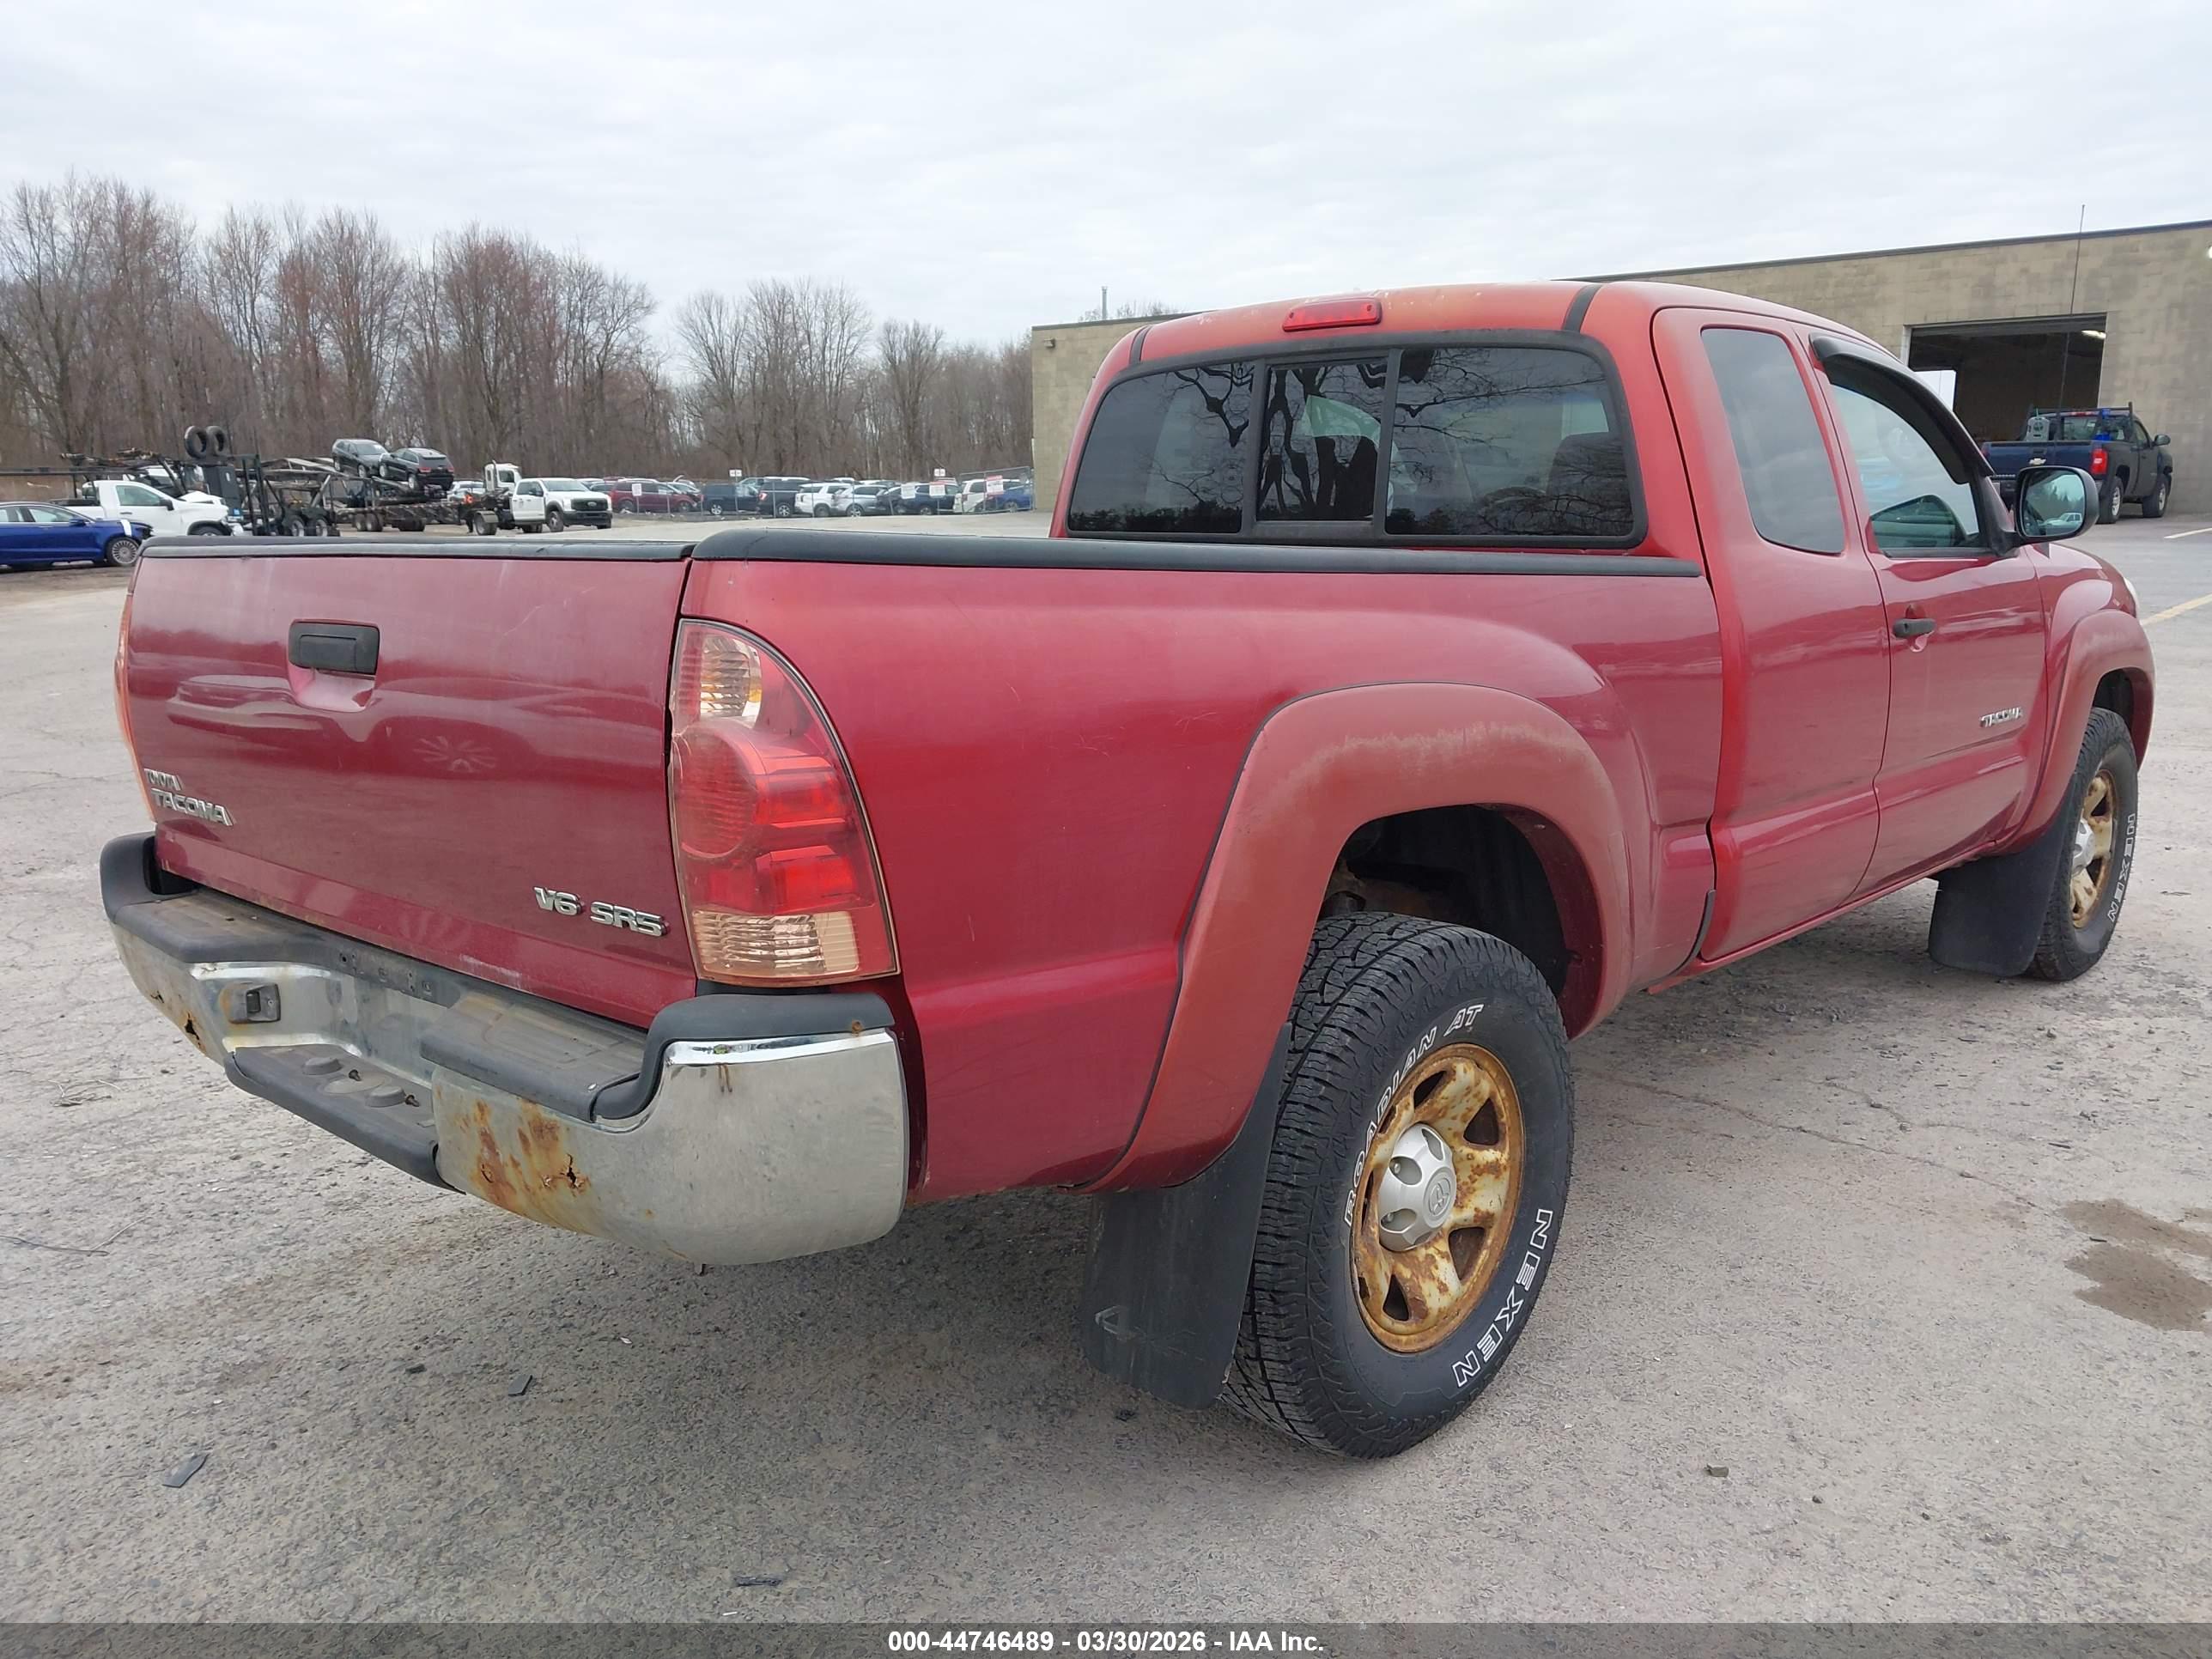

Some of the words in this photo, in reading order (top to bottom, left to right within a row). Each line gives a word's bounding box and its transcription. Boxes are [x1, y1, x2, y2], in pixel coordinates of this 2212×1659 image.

[151, 787, 234, 826] TACOMA
[533, 886, 580, 916] V6
[590, 901, 665, 938] SR5
[2107, 813, 2136, 923] NEXEN
[1344, 1027, 1437, 1227] ROADIAN
[1443, 1004, 1485, 1037] AT
[1452, 1208, 1553, 1388] NEXEN
